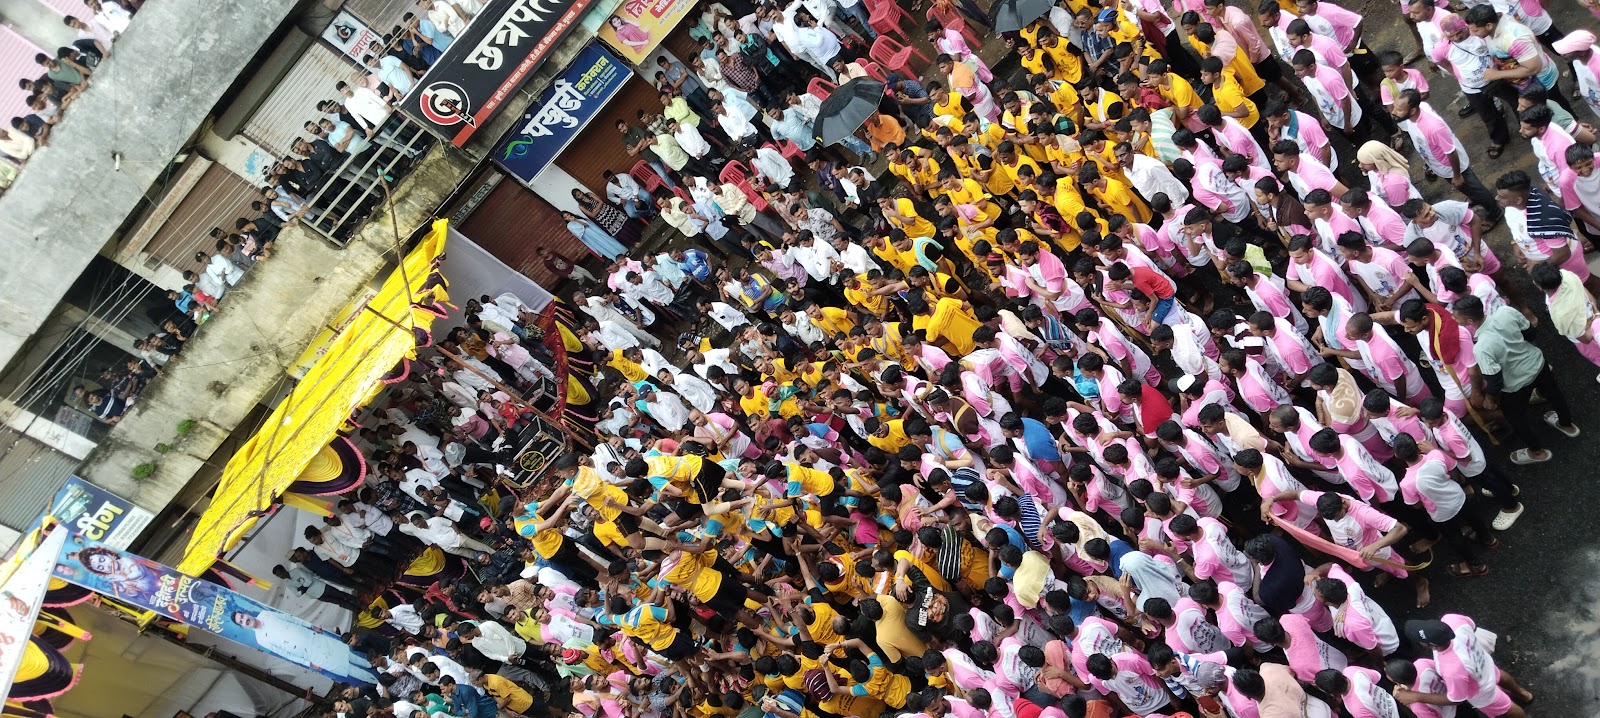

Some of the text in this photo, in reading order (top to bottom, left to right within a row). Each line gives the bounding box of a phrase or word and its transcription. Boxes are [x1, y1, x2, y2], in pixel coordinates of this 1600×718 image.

[575, 56, 608, 91] कलेक्शन
[78, 501, 123, 540] टींग
[918, 607, 928, 627] RISE
